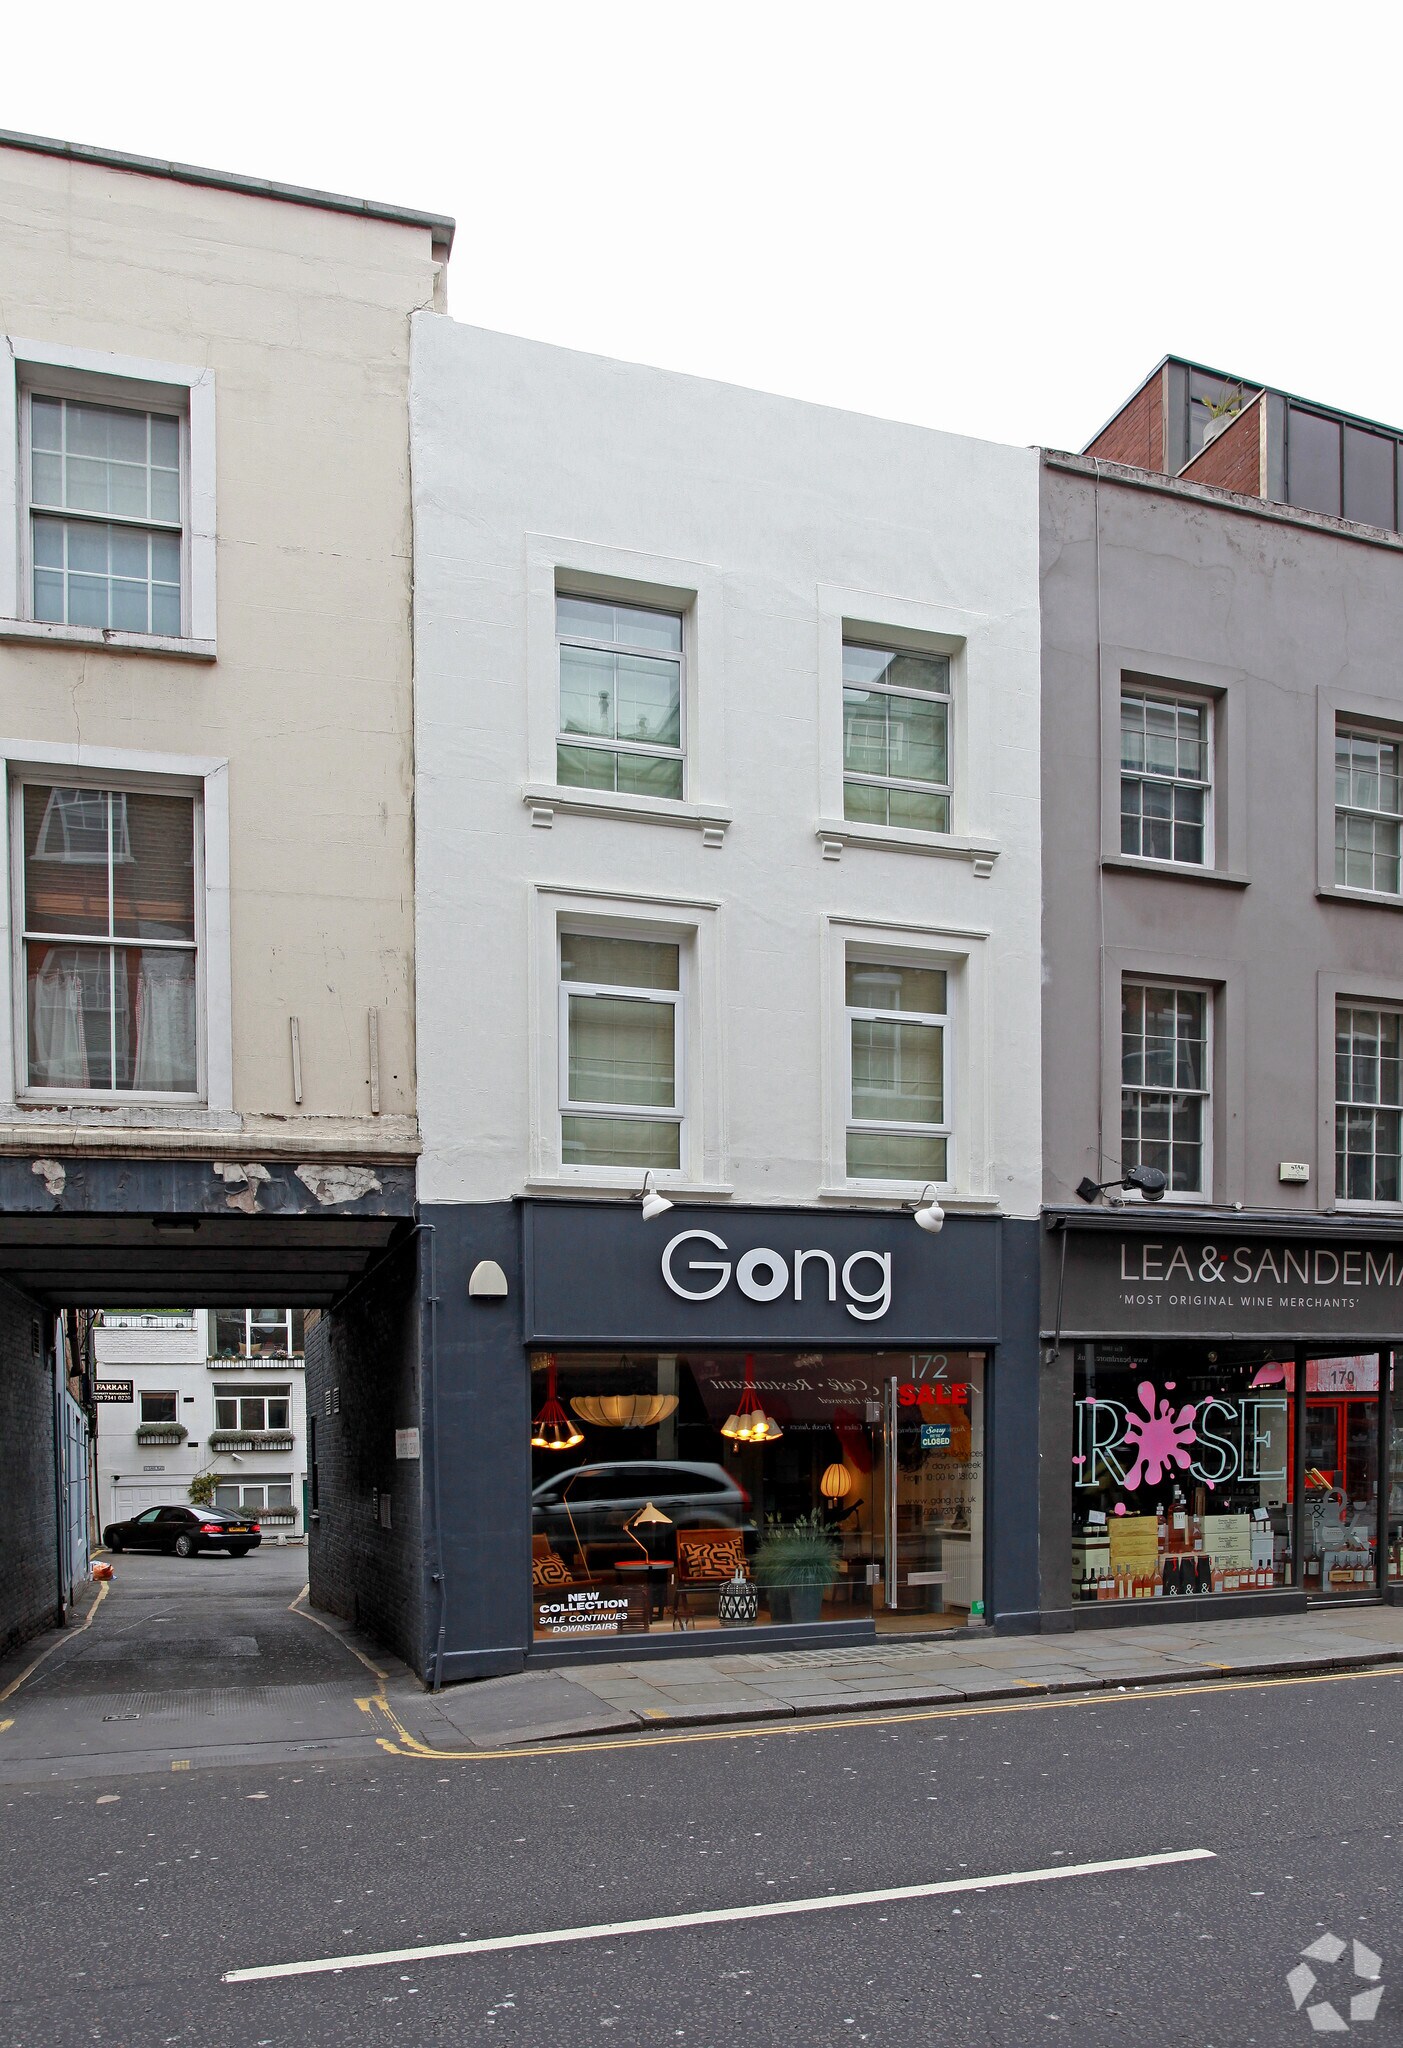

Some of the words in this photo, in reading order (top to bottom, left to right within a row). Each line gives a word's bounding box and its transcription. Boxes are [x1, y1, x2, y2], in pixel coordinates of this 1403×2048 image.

[661, 1229, 891, 1321] Gong
[1169, 1295, 1234, 1306] ORIGINAL
[1241, 1297, 1273, 1307] WINE
[910, 1354, 948, 1379] 172
[1331, 1371, 1354, 1384] 170
[96, 1383, 129, 1391] FARRAR
[899, 1383, 968, 1406] SALE
[925, 1426, 946, 1436] Sorry
[922, 1437, 950, 1446] CLOSED
[932, 1462, 951, 1471] days
[961, 1461, 981, 1469] week
[567, 1592, 599, 1602] NEW
[539, 1599, 628, 1613] COLLECTION
[539, 1615, 566, 1624] SALE
[569, 1612, 628, 1623] CONTINUES
[552, 1623, 618, 1633] DOWNSTAIRS
